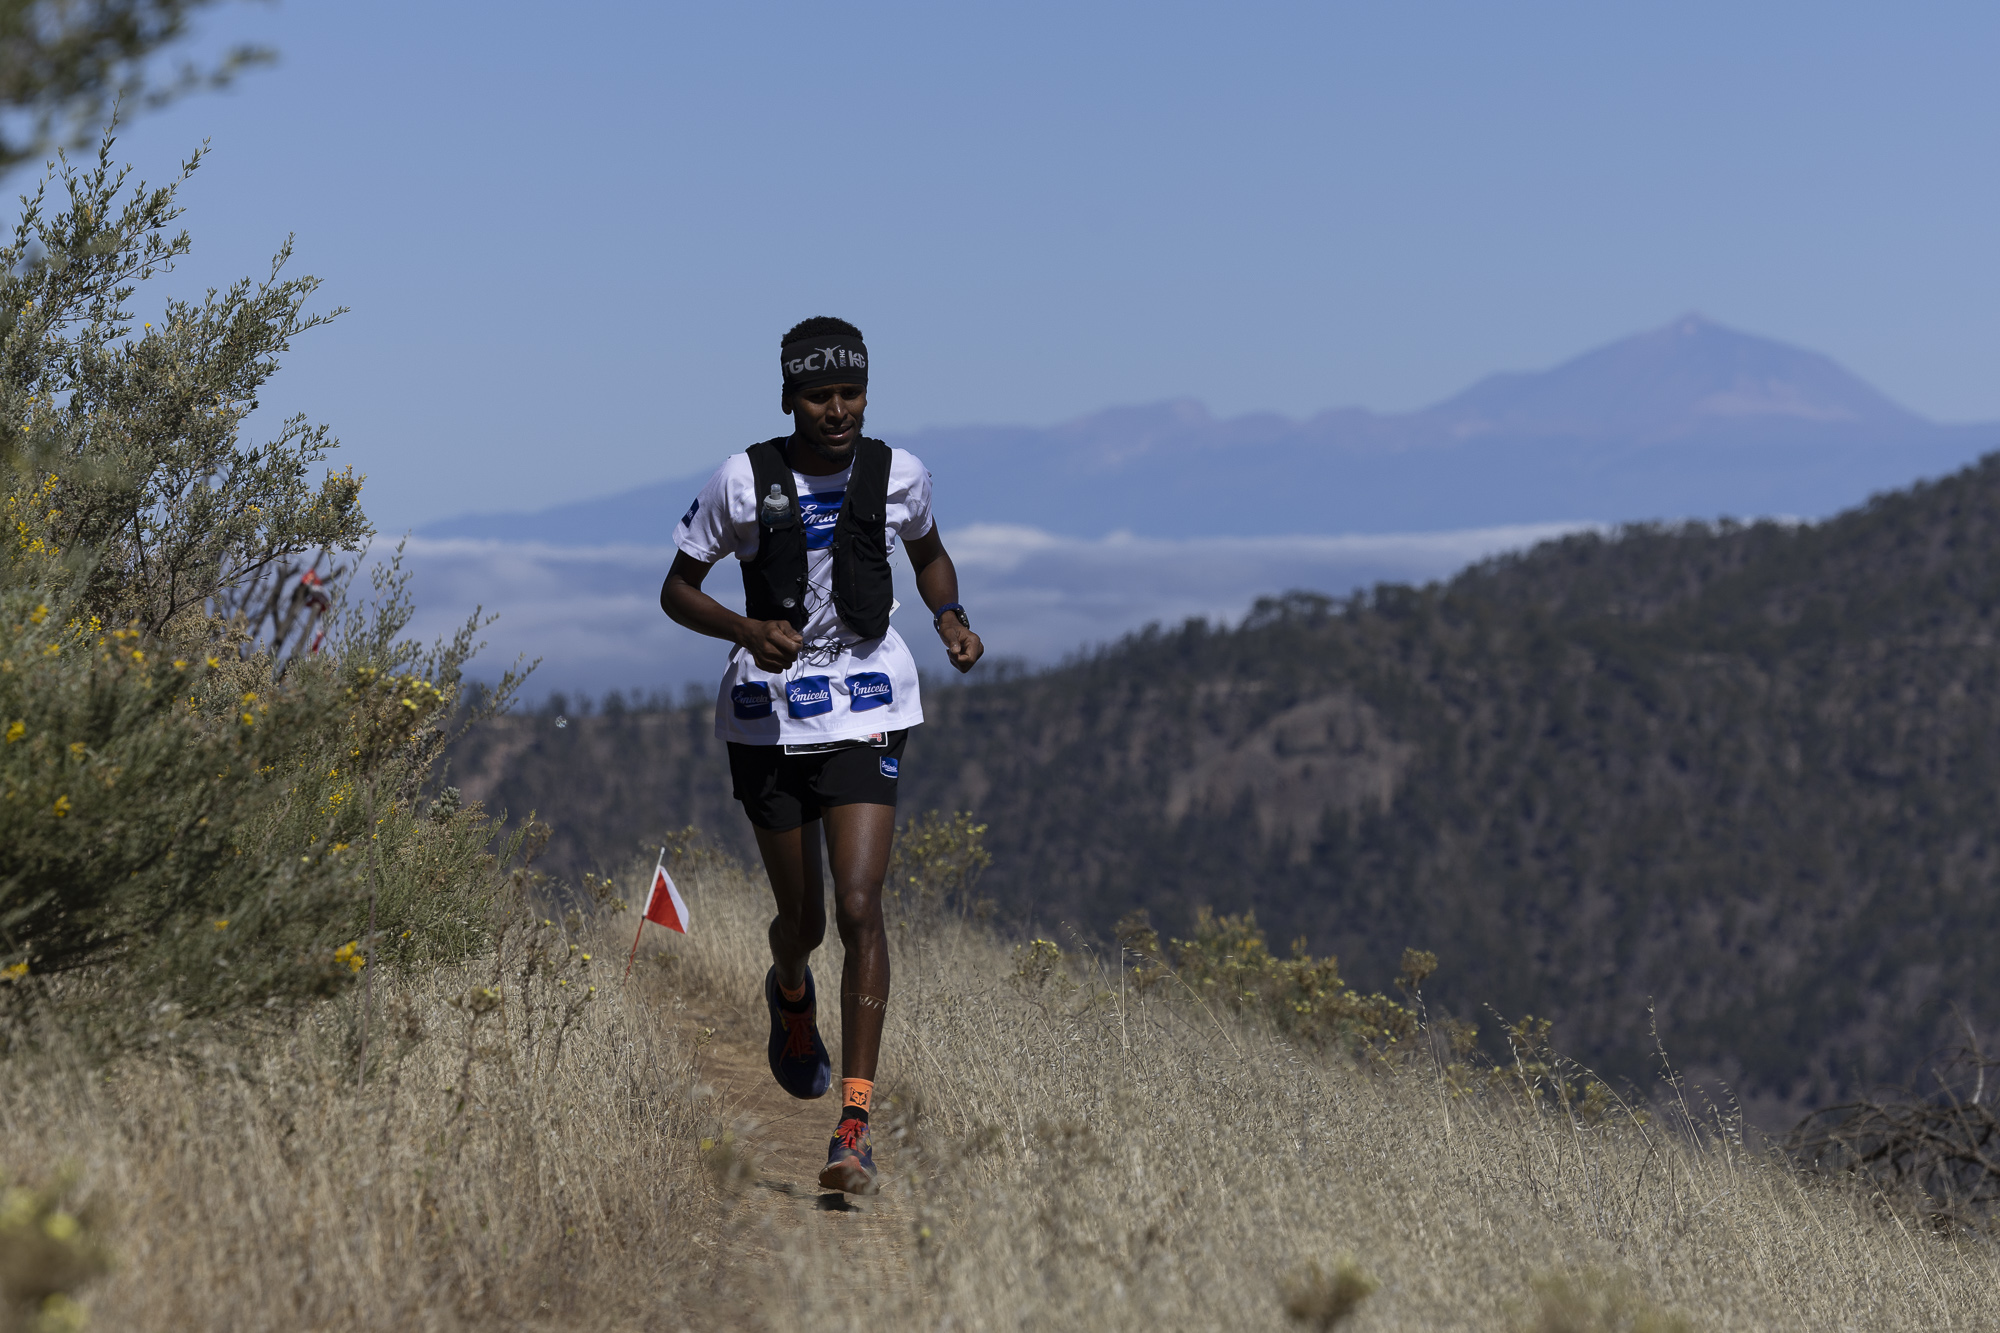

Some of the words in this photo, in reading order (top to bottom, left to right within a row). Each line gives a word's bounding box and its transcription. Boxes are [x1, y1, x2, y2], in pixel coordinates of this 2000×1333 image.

[783, 353, 820, 377] TGC
[800, 504, 839, 525] Emic
[789, 687, 830, 703] Emicela
[851, 681, 890, 697] Emicela
[734, 690, 770, 705] Emicela
